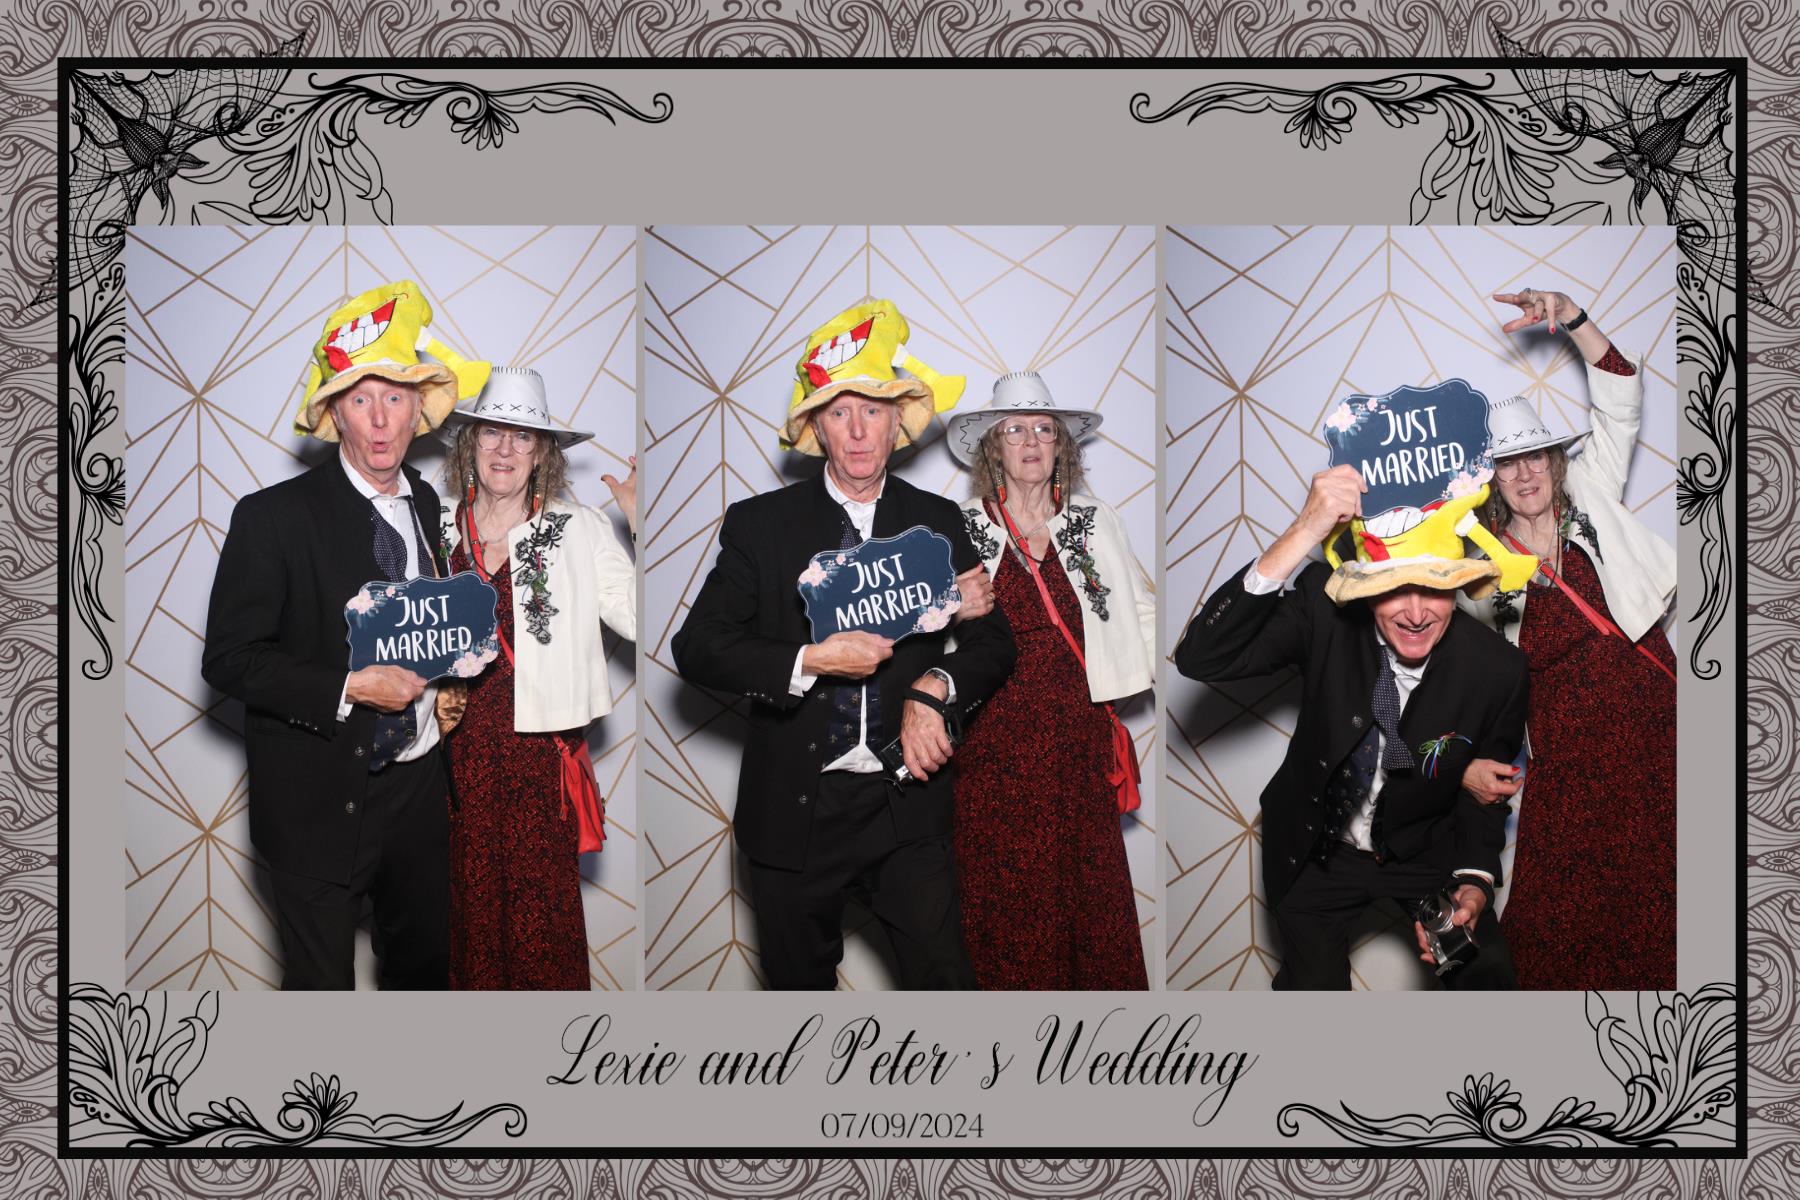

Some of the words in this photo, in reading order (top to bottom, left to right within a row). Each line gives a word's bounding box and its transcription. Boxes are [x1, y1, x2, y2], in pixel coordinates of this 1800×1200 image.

[1378, 405, 1437, 446] JUST
[1361, 442, 1465, 487] MARRIED
[848, 553, 905, 594] JUST
[394, 594, 450, 628] JUST
[835, 582, 932, 632] MARRIED
[375, 626, 472, 663] MARRIED
